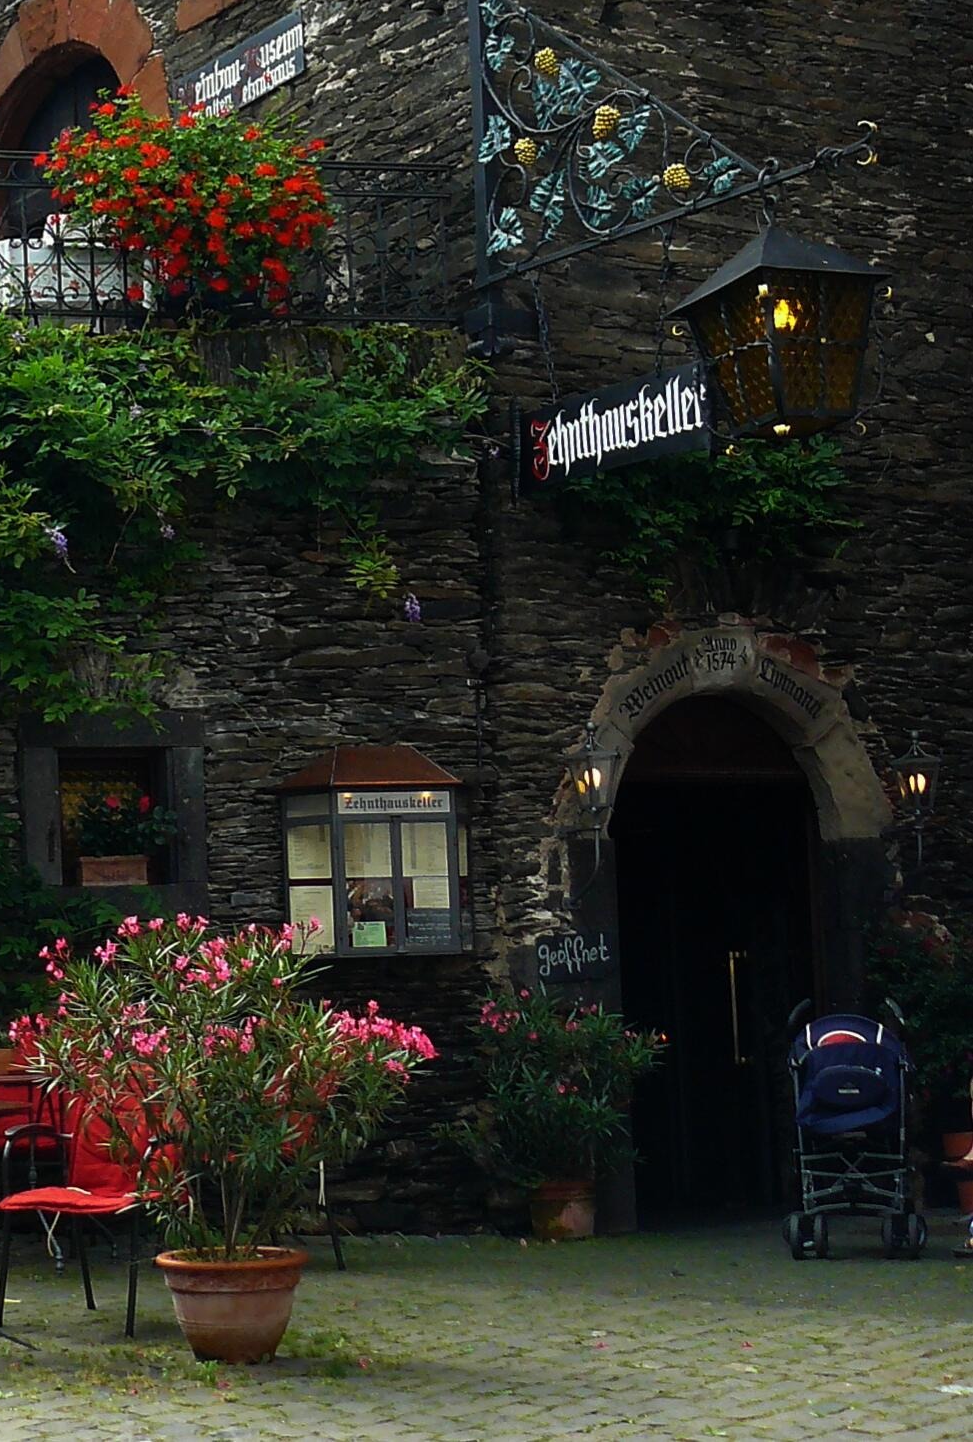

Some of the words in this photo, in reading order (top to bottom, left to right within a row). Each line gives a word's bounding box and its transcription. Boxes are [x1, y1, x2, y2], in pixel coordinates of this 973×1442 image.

[530, 374, 707, 482] Zehnthauskeller
[701, 635, 738, 653] Anno
[706, 652, 737, 673] 1574
[619, 652, 690, 719] Weingut
[344, 795, 445, 813] Zehnthauskeller
[537, 931, 612, 976] geöffnet
